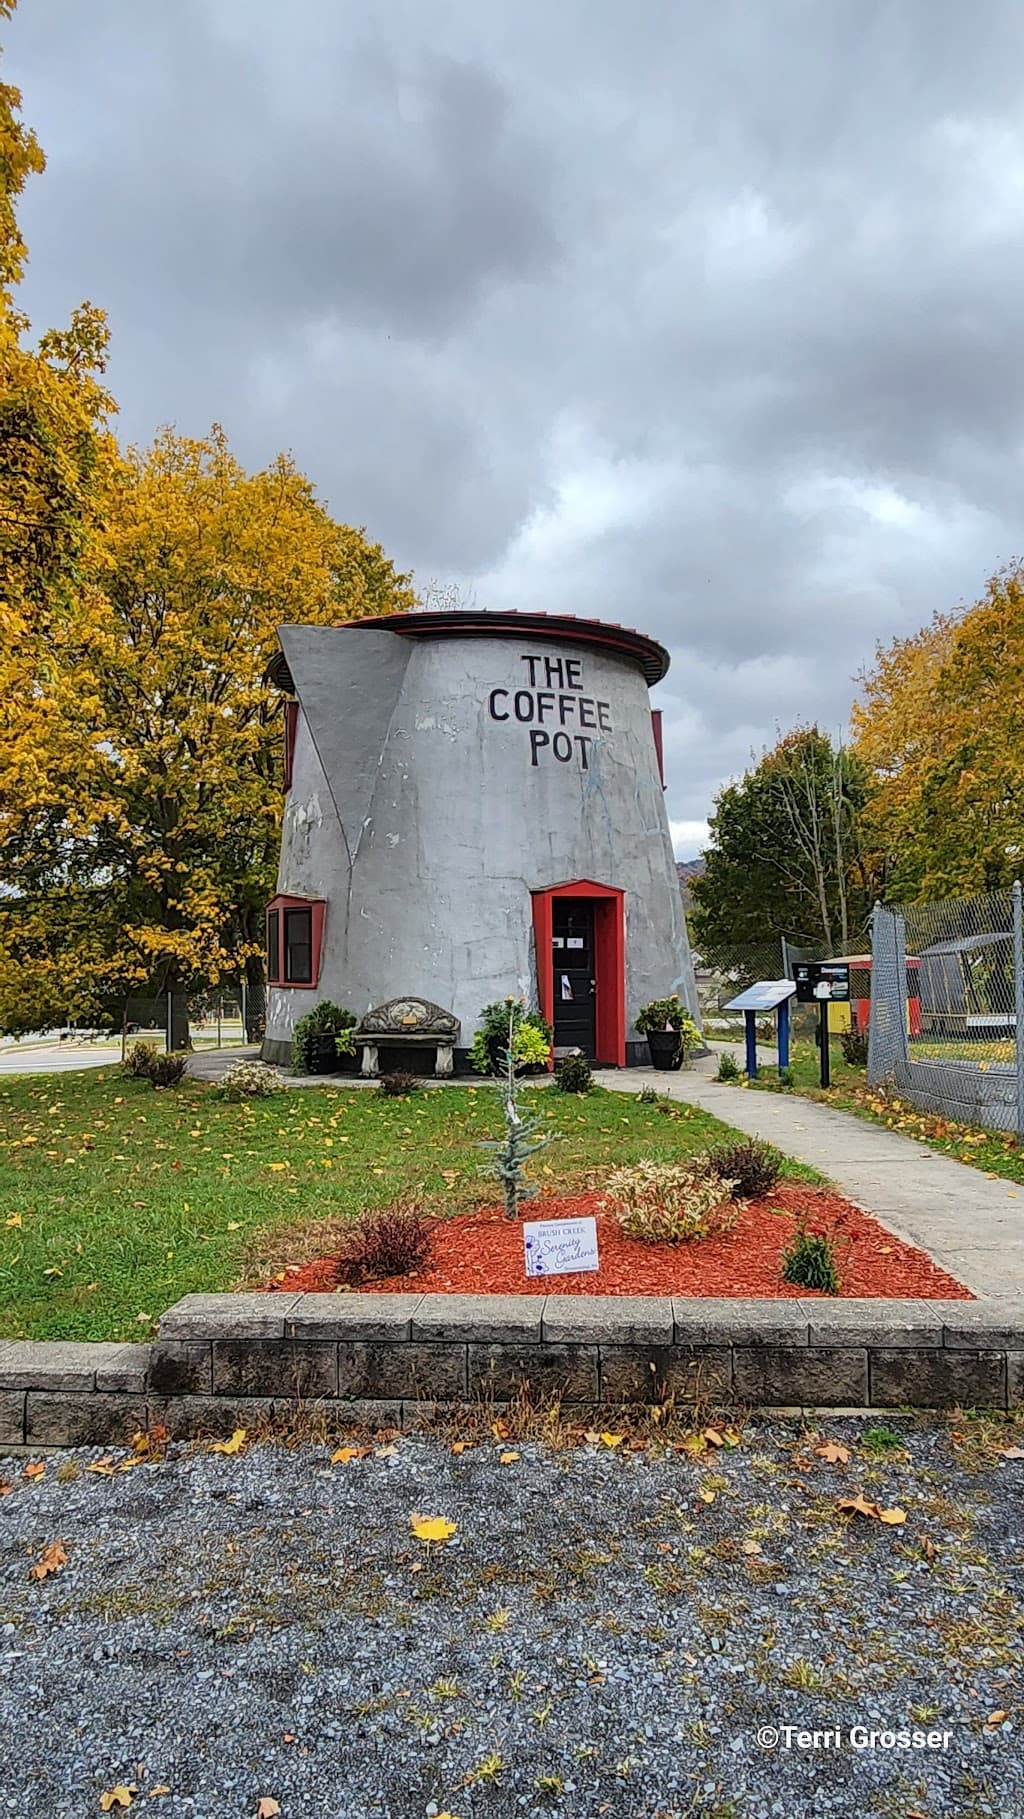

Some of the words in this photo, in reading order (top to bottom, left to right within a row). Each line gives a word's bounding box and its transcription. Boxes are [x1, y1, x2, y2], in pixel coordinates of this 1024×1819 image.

[520, 655, 584, 691] THE
[489, 688, 613, 733] COFFEE
[529, 730, 593, 770] POT
[538, 1229, 561, 1238] BRUSH
[541, 1238, 581, 1255] Serenity
[555, 1247, 596, 1269] Gardens
